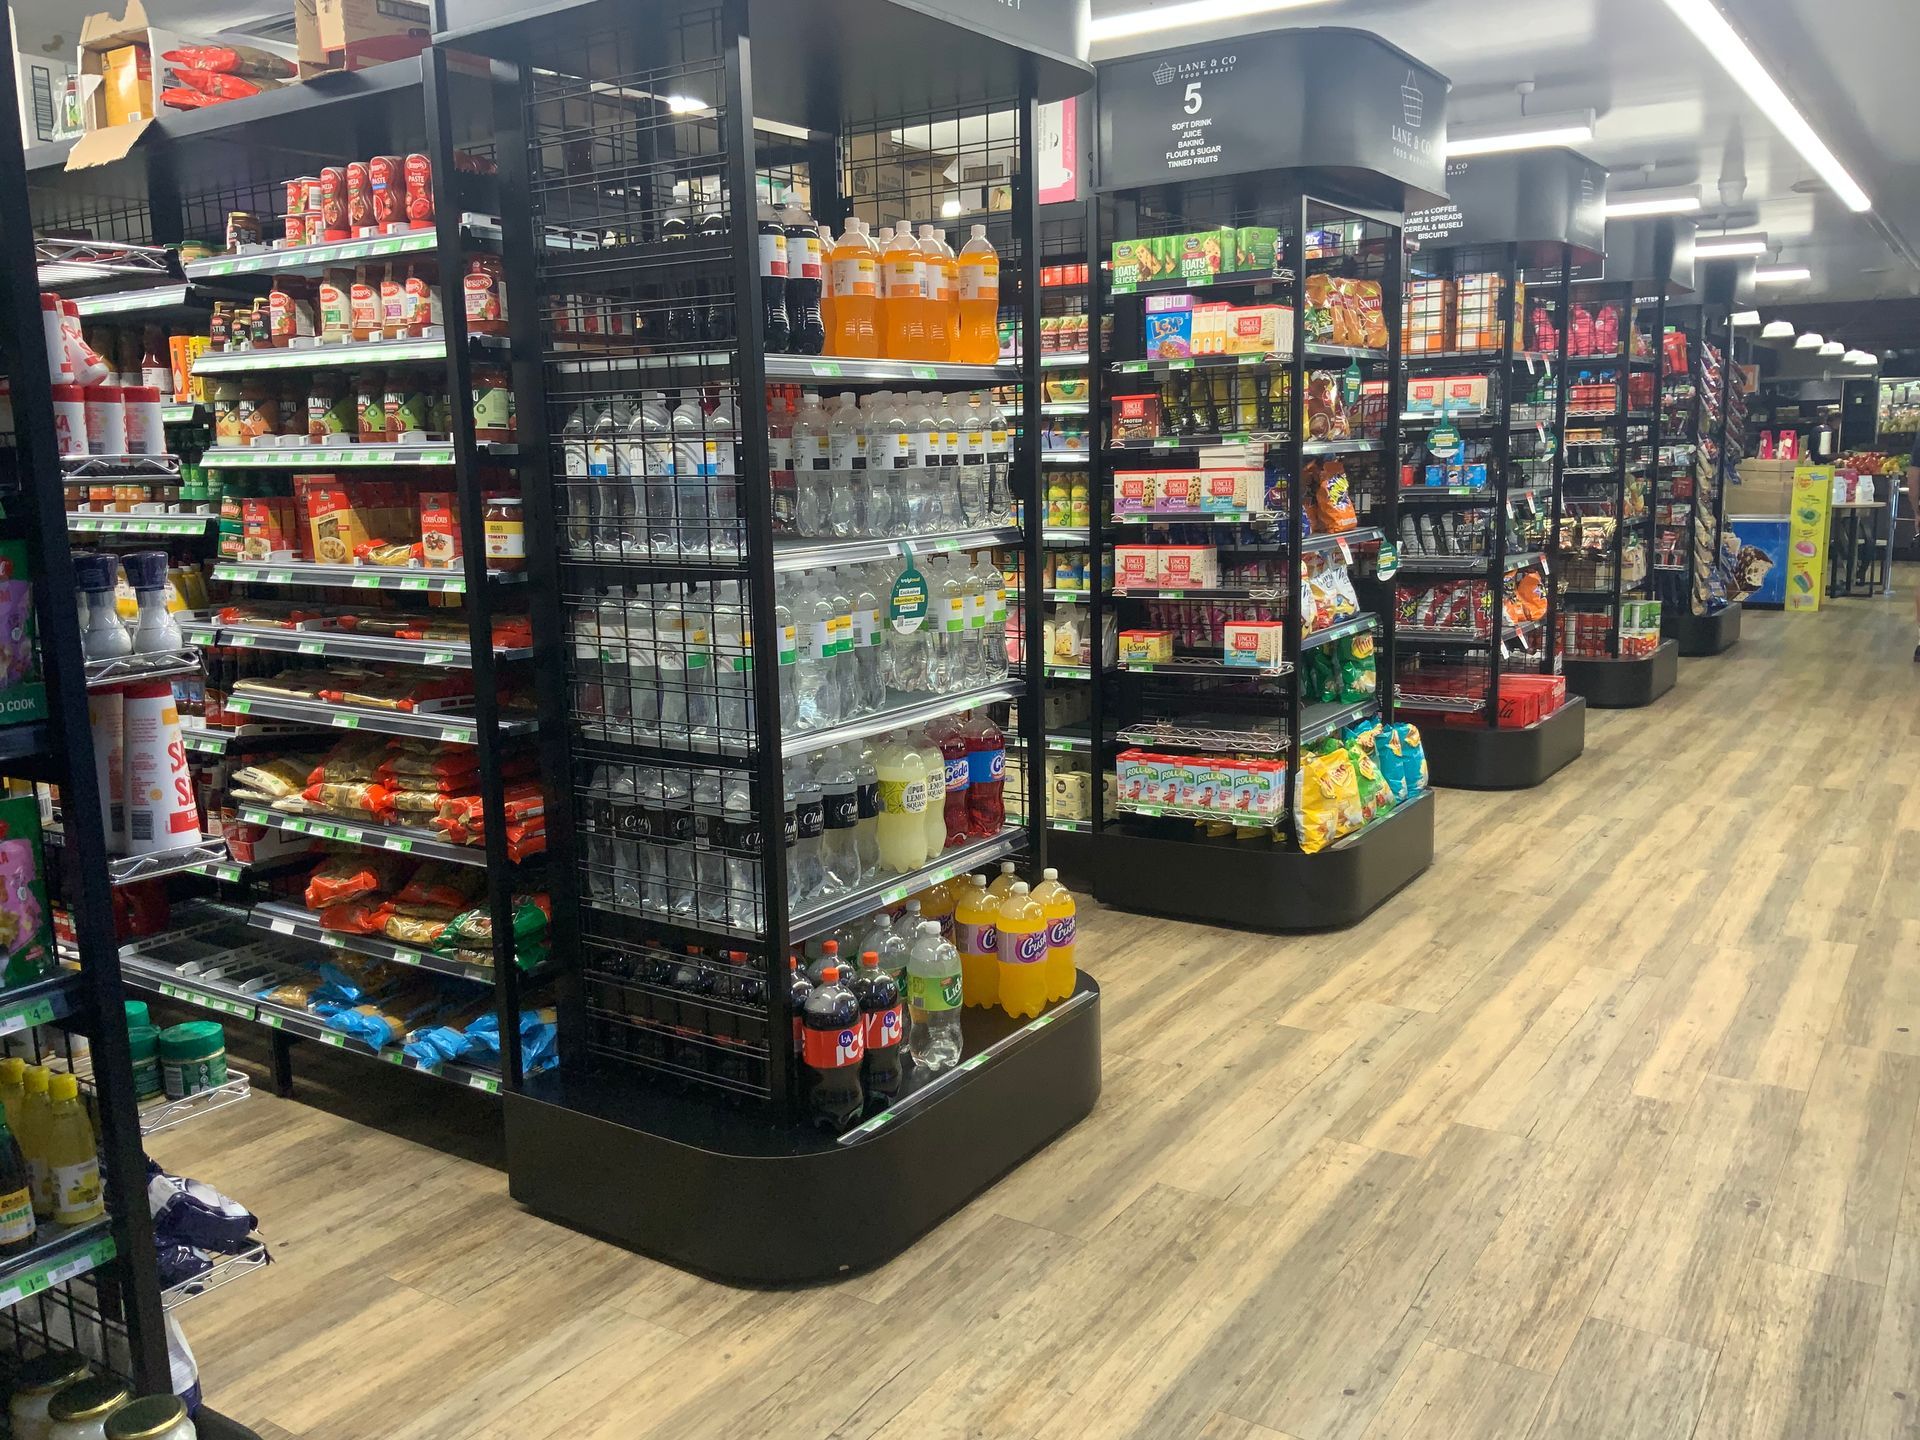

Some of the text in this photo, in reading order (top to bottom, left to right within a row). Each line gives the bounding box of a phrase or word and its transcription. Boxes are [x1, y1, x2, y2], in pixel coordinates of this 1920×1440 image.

[1178, 55, 1237, 73] LANE & CO
[1203, 66, 1234, 75] MARKET
[1183, 81, 1203, 115] 5
[1171, 118, 1212, 131] SOFT DRINK
[1182, 129, 1202, 138] JUICE
[1177, 138, 1205, 149] BAKING
[1391, 124, 1432, 156] LANE & CO
[1166, 149, 1189, 160] FLOUR
[1196, 145, 1222, 155] SUGAR
[1167, 155, 1219, 169] TINNED FRUITS
[1455, 162, 1468, 170] CO
[408, 175, 425, 183] PASTE
[1430, 205, 1458, 214] COFFEE
[1404, 212, 1463, 225] JAMS & SPREADS
[1403, 223, 1431, 233] CEREAL
[1438, 220, 1464, 230] MUSELI
[1417, 230, 1448, 240] BISCUITS
[1185, 258, 1205, 270] OATY
[1120, 266, 1137, 278] OATY
[1181, 270, 1205, 278] SLICES
[1115, 276, 1137, 284] SLICES
[1634, 295, 1670, 303] BATTERS
[7, 697, 36, 710] COOK
[803, 811, 823, 826] Club
[785, 818, 797, 834] lub
[1021, 932, 1047, 956] Crush
